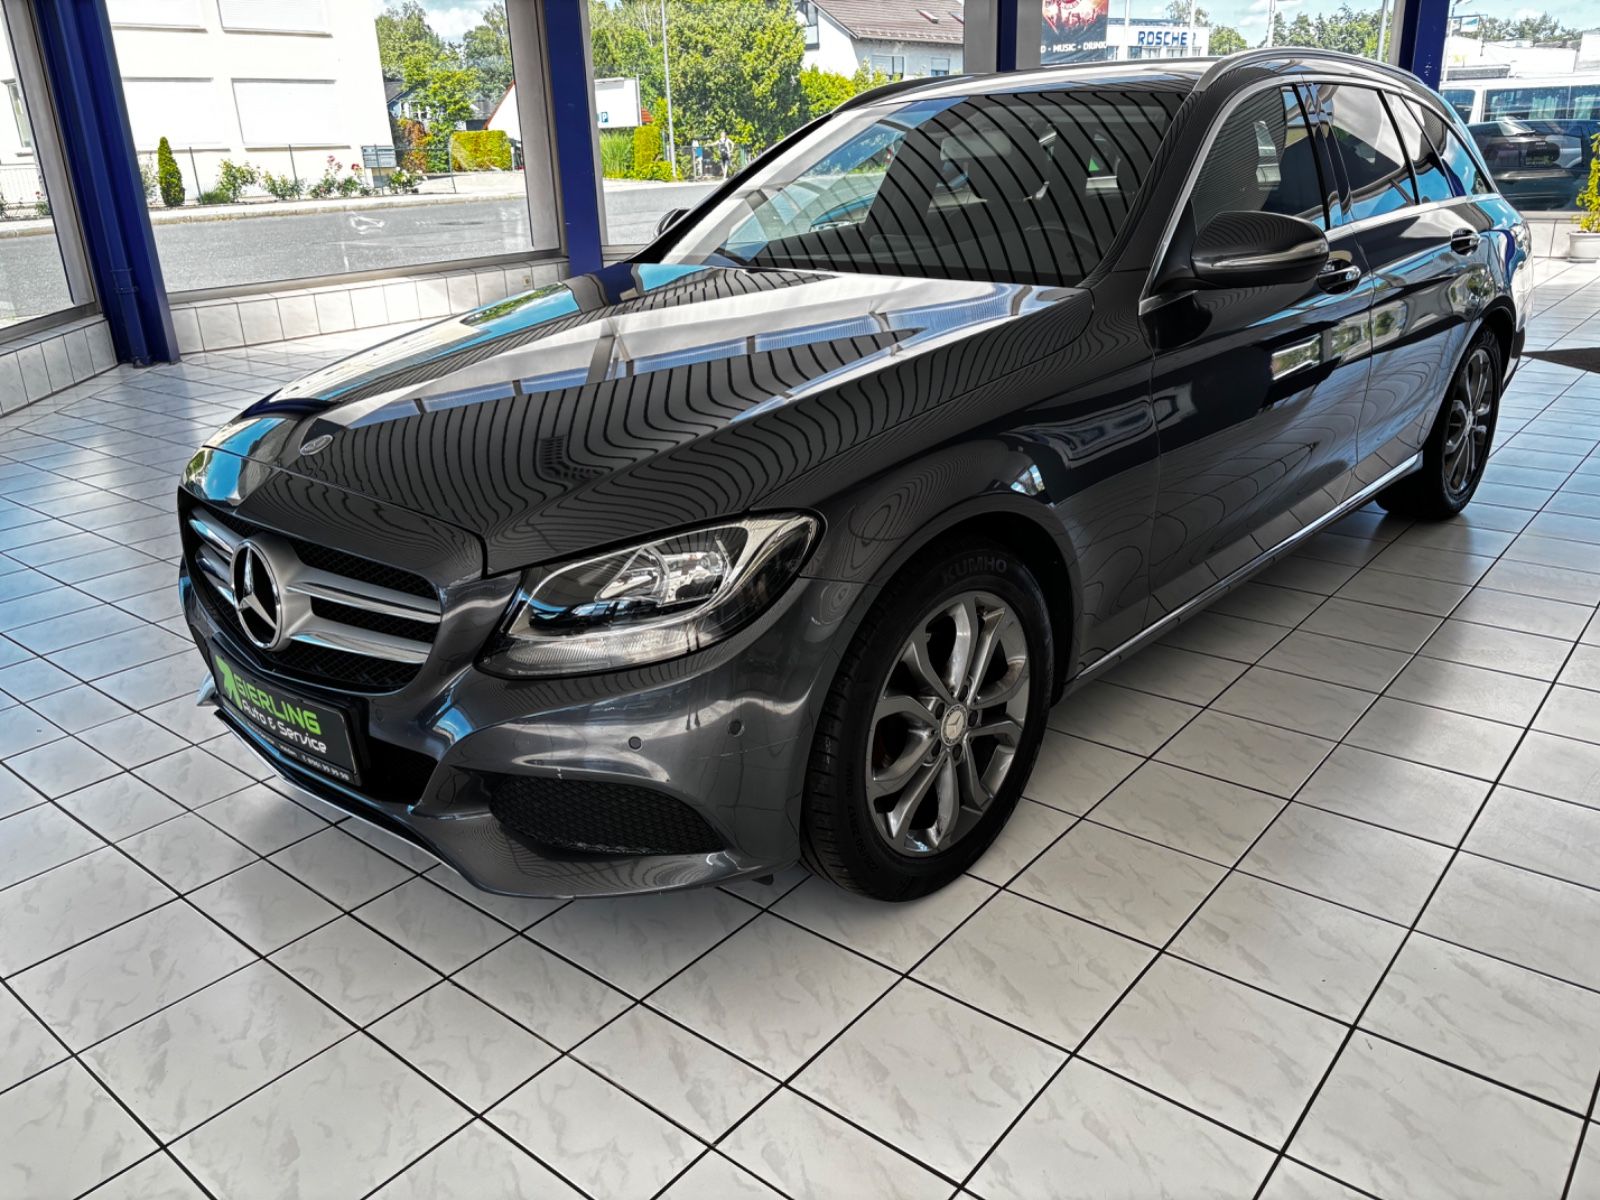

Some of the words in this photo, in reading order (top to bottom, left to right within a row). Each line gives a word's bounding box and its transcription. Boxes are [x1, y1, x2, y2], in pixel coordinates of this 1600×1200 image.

[1053, 43, 1077, 53] MUSIC
[942, 555, 1007, 583] KUMHO
[242, 699, 267, 725] Auto
[277, 721, 327, 754] Service
